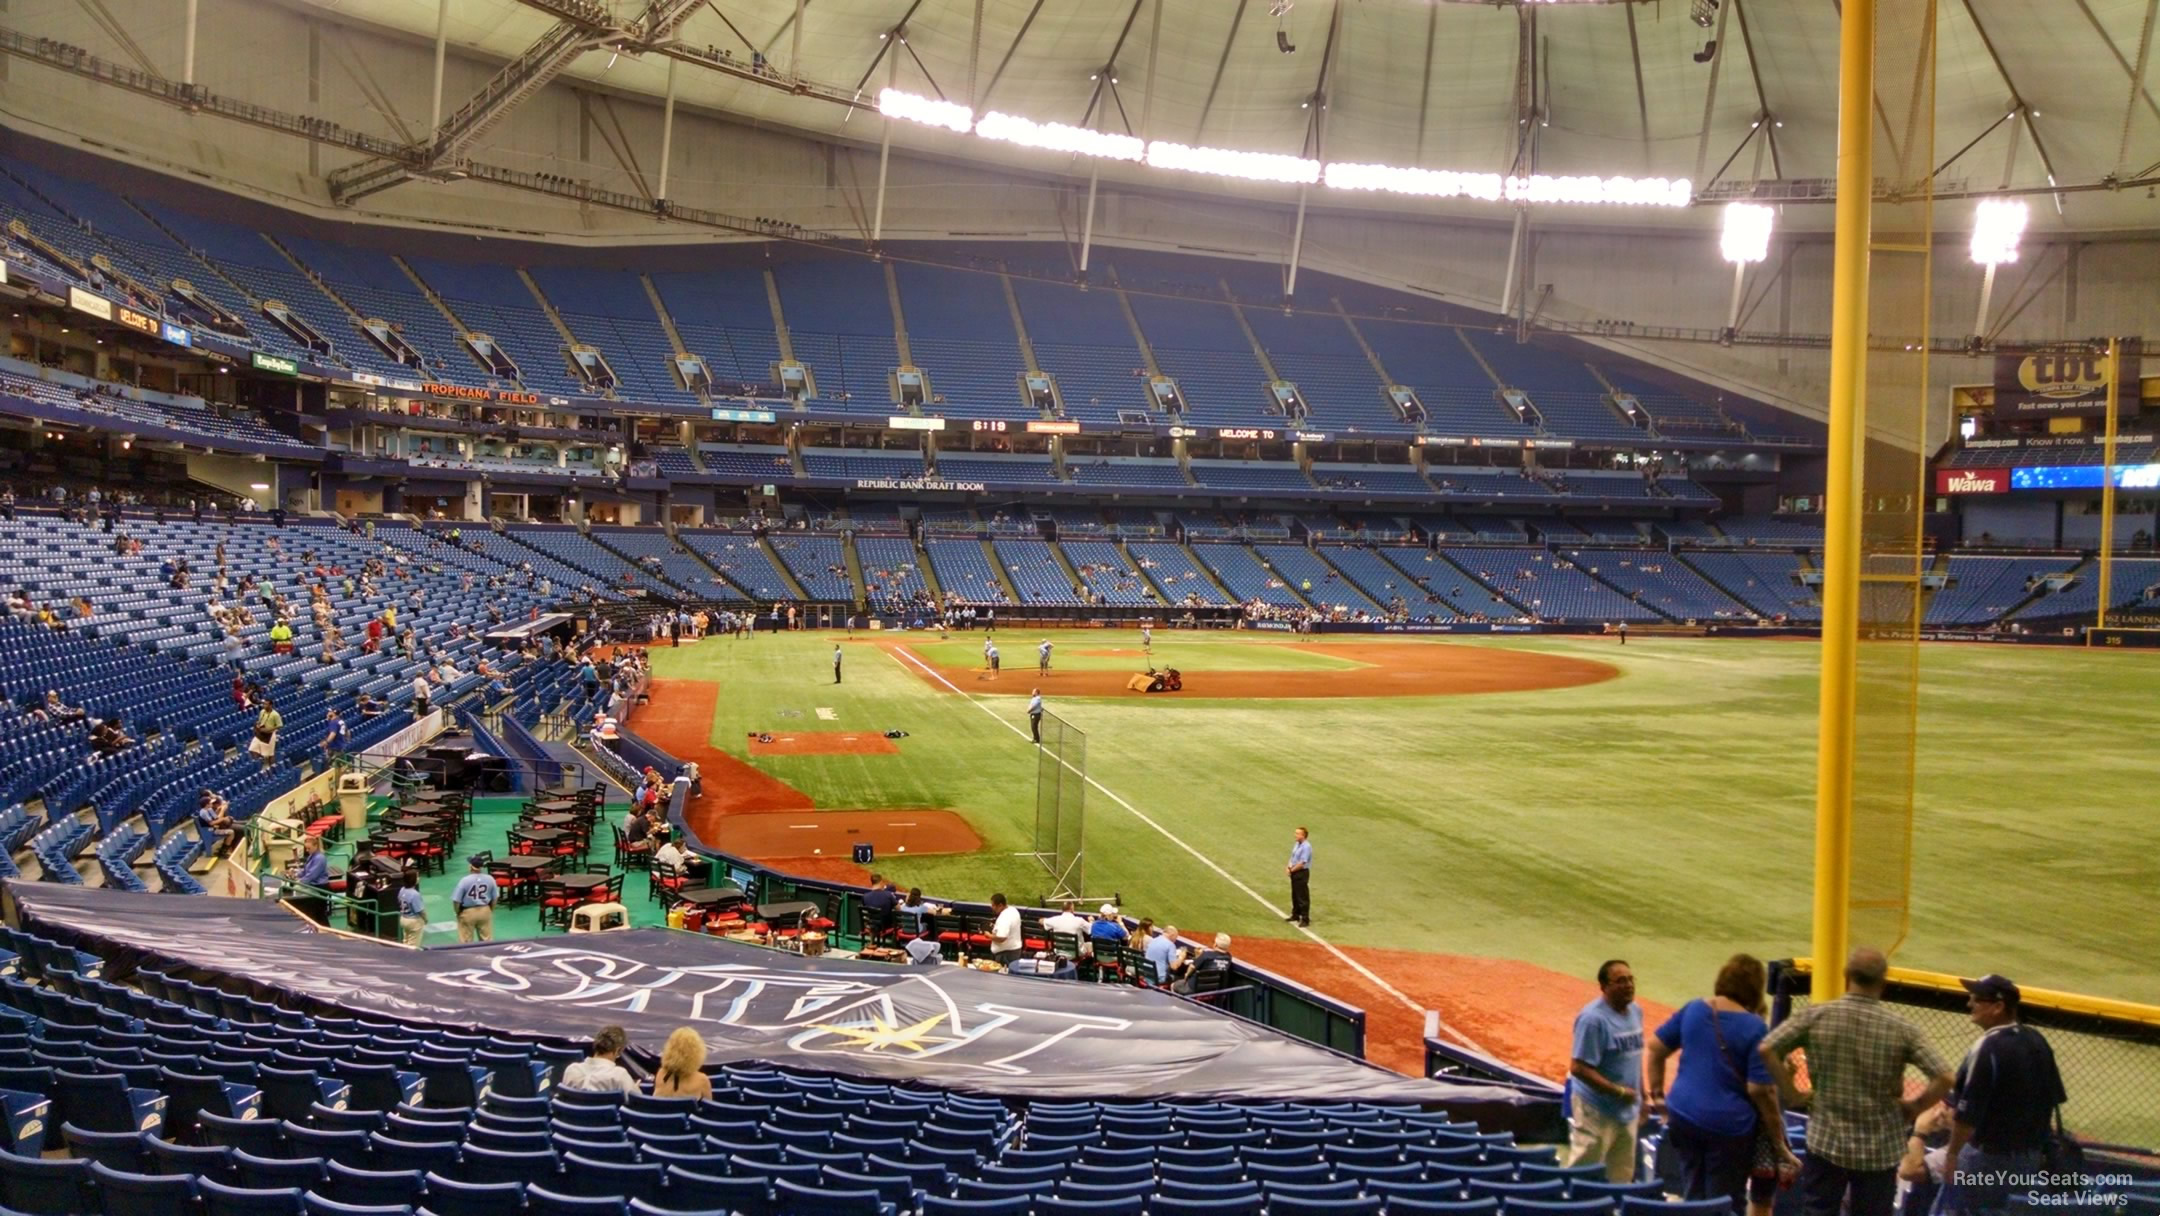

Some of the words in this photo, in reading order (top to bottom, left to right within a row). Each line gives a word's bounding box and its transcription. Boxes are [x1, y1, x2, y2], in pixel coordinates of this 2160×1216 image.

[120, 308, 147, 330] WELCOME
[149, 319, 158, 333] TO
[2031, 347, 2102, 385] tbt
[423, 384, 491, 399] TROPICANA
[500, 392, 538, 404] FIELD
[2061, 402, 2076, 410] you
[973, 420, 1006, 431] 6:19
[1219, 429, 1258, 438] WELCOME
[1263, 431, 1274, 439] TO
[2026, 438, 2053, 446] Know
[857, 480, 898, 488] REPUBLIC
[900, 481, 923, 489] BANK
[926, 481, 954, 490] DRAFT
[957, 482, 984, 490] ROOM
[1948, 477, 1996, 492] Wawa
[468, 884, 488, 900] 42
